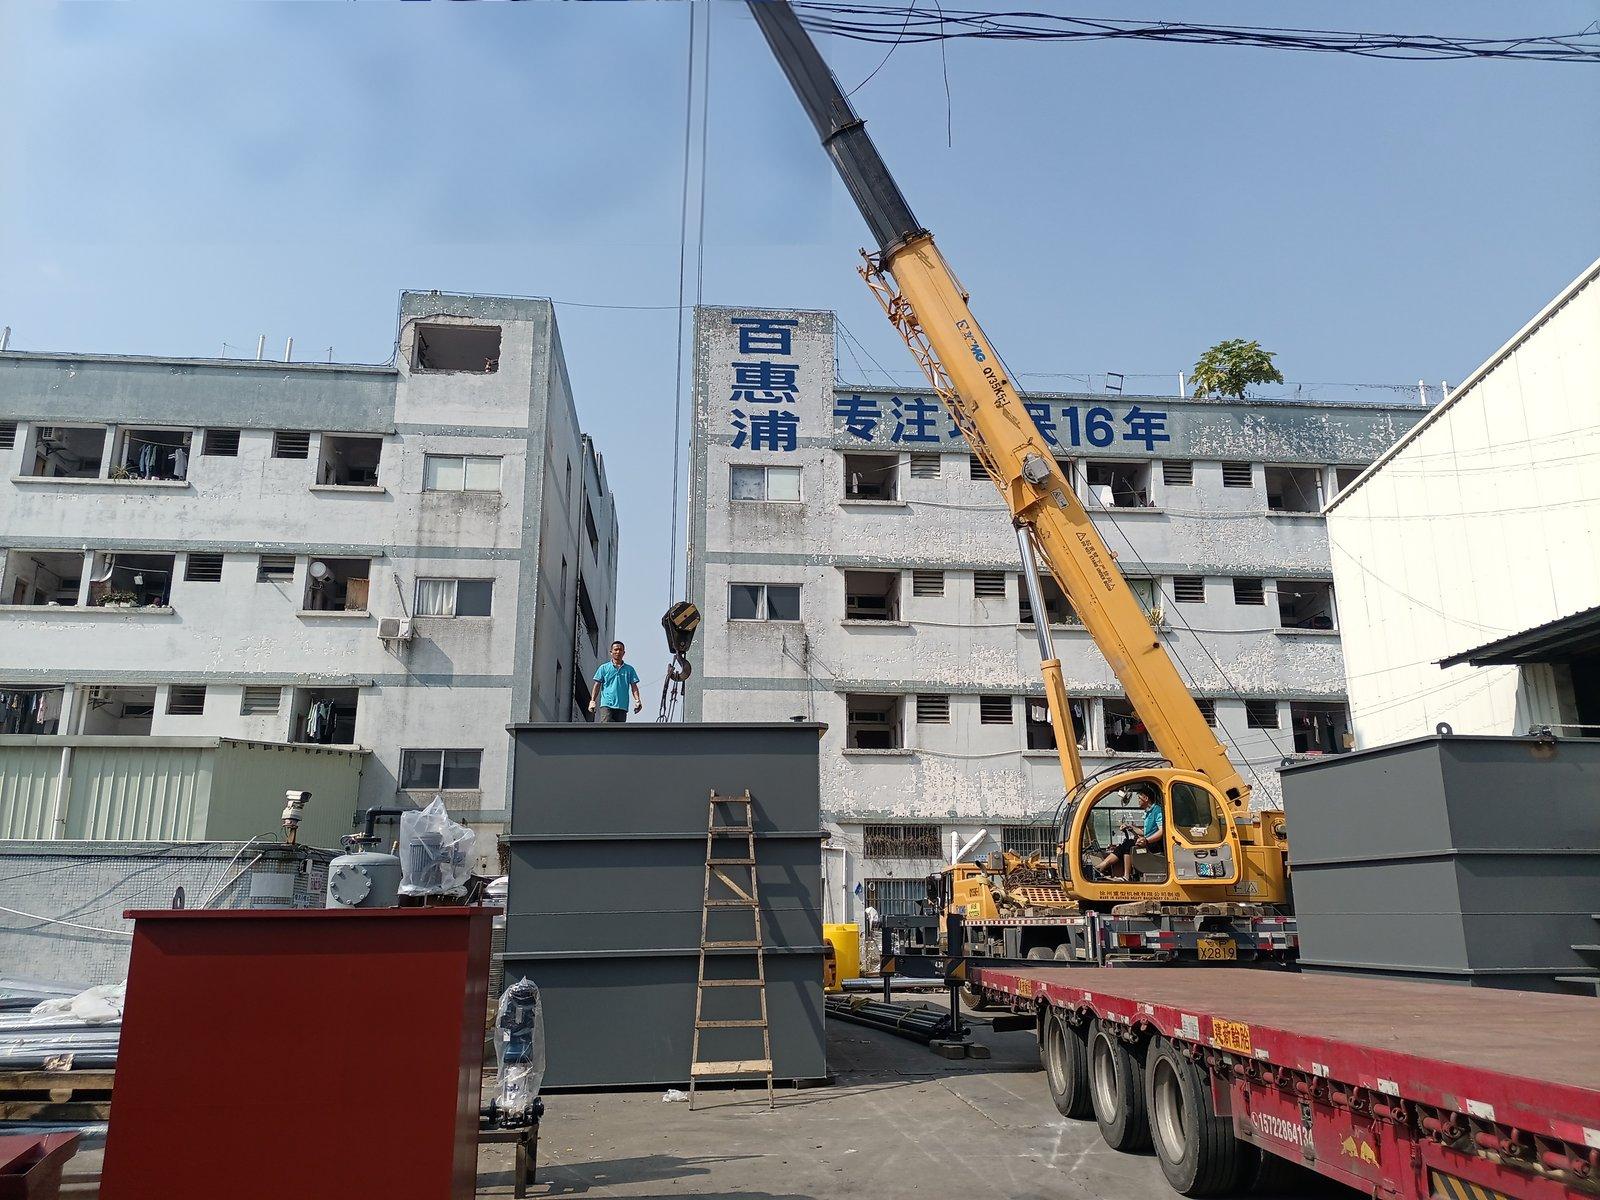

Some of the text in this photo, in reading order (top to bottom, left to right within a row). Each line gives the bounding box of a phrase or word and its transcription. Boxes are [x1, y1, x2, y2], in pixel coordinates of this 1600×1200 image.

[729, 318, 799, 451] 百惠浦
[1200, 947, 1235, 959] X2819
